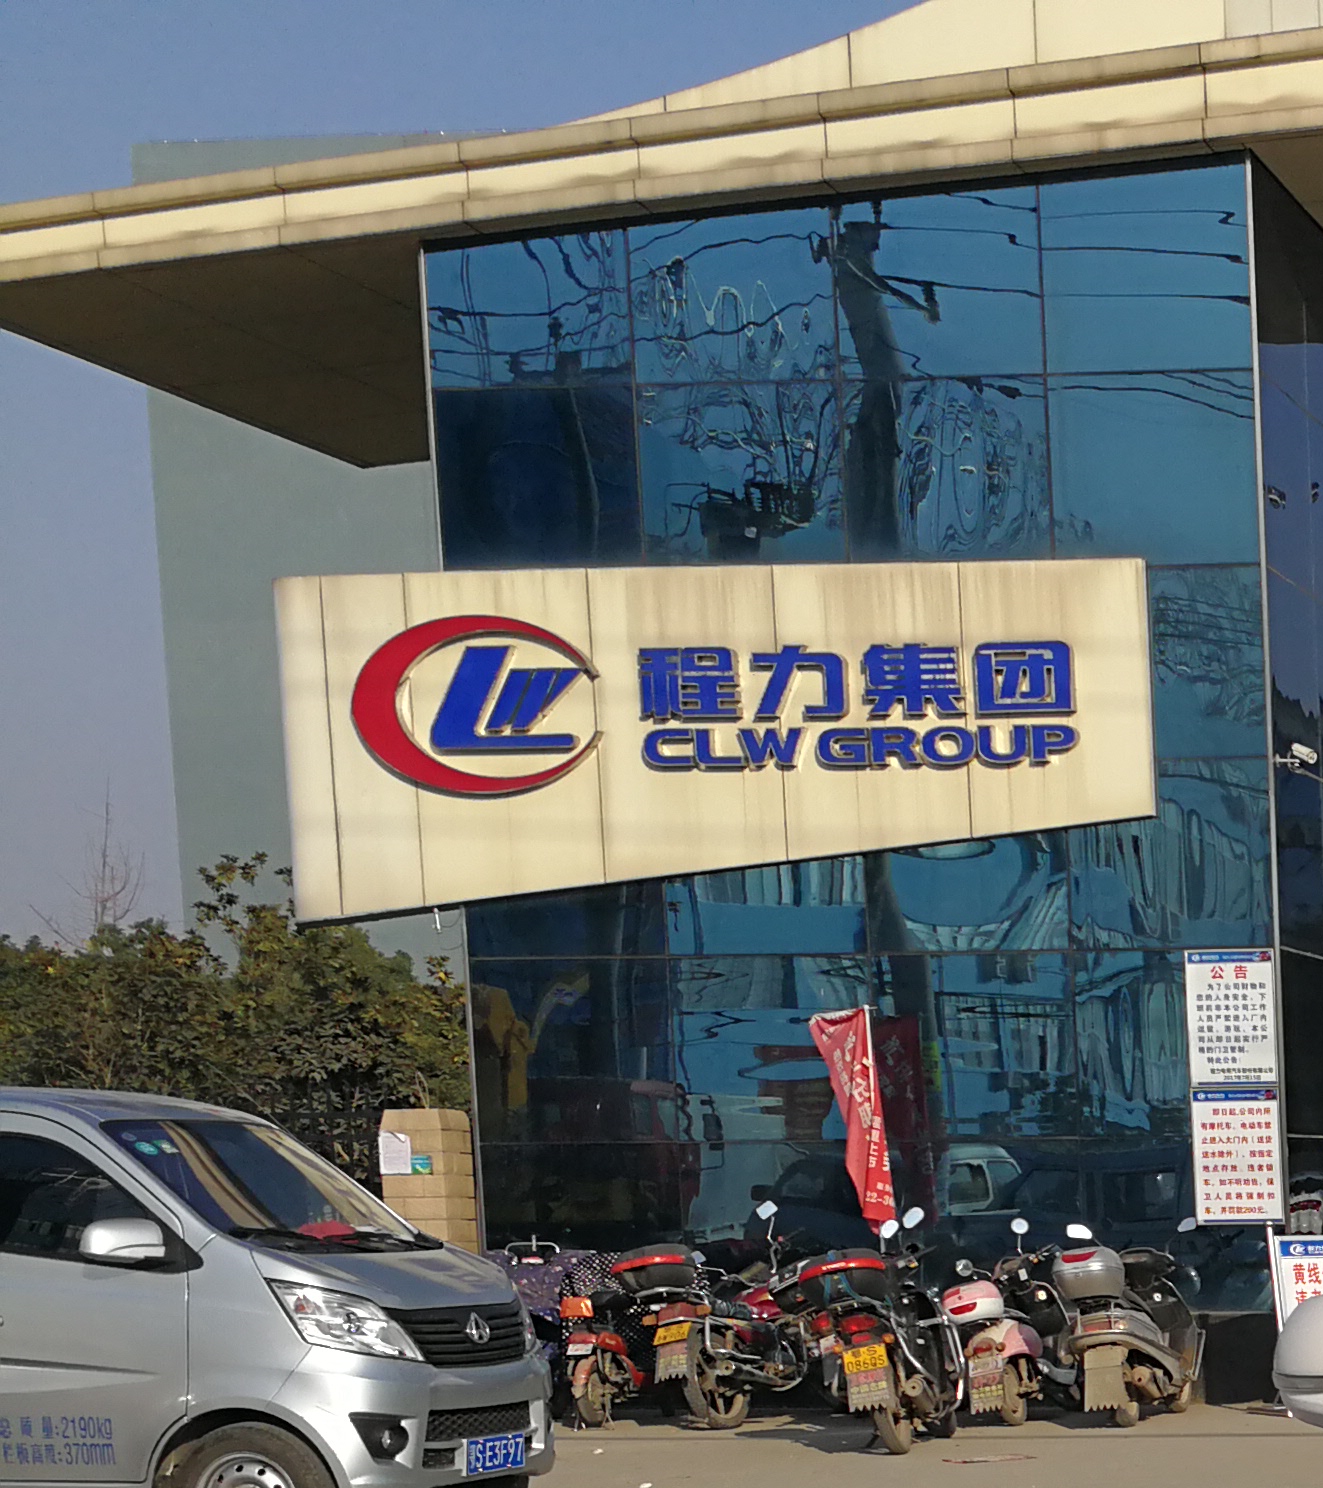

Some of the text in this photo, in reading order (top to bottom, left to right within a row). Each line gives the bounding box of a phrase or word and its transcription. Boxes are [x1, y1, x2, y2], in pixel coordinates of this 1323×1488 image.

[637, 639, 1078, 724] 程力集团
[642, 723, 1080, 772] CLW GROUP
[1210, 965, 1248, 979] 公告
